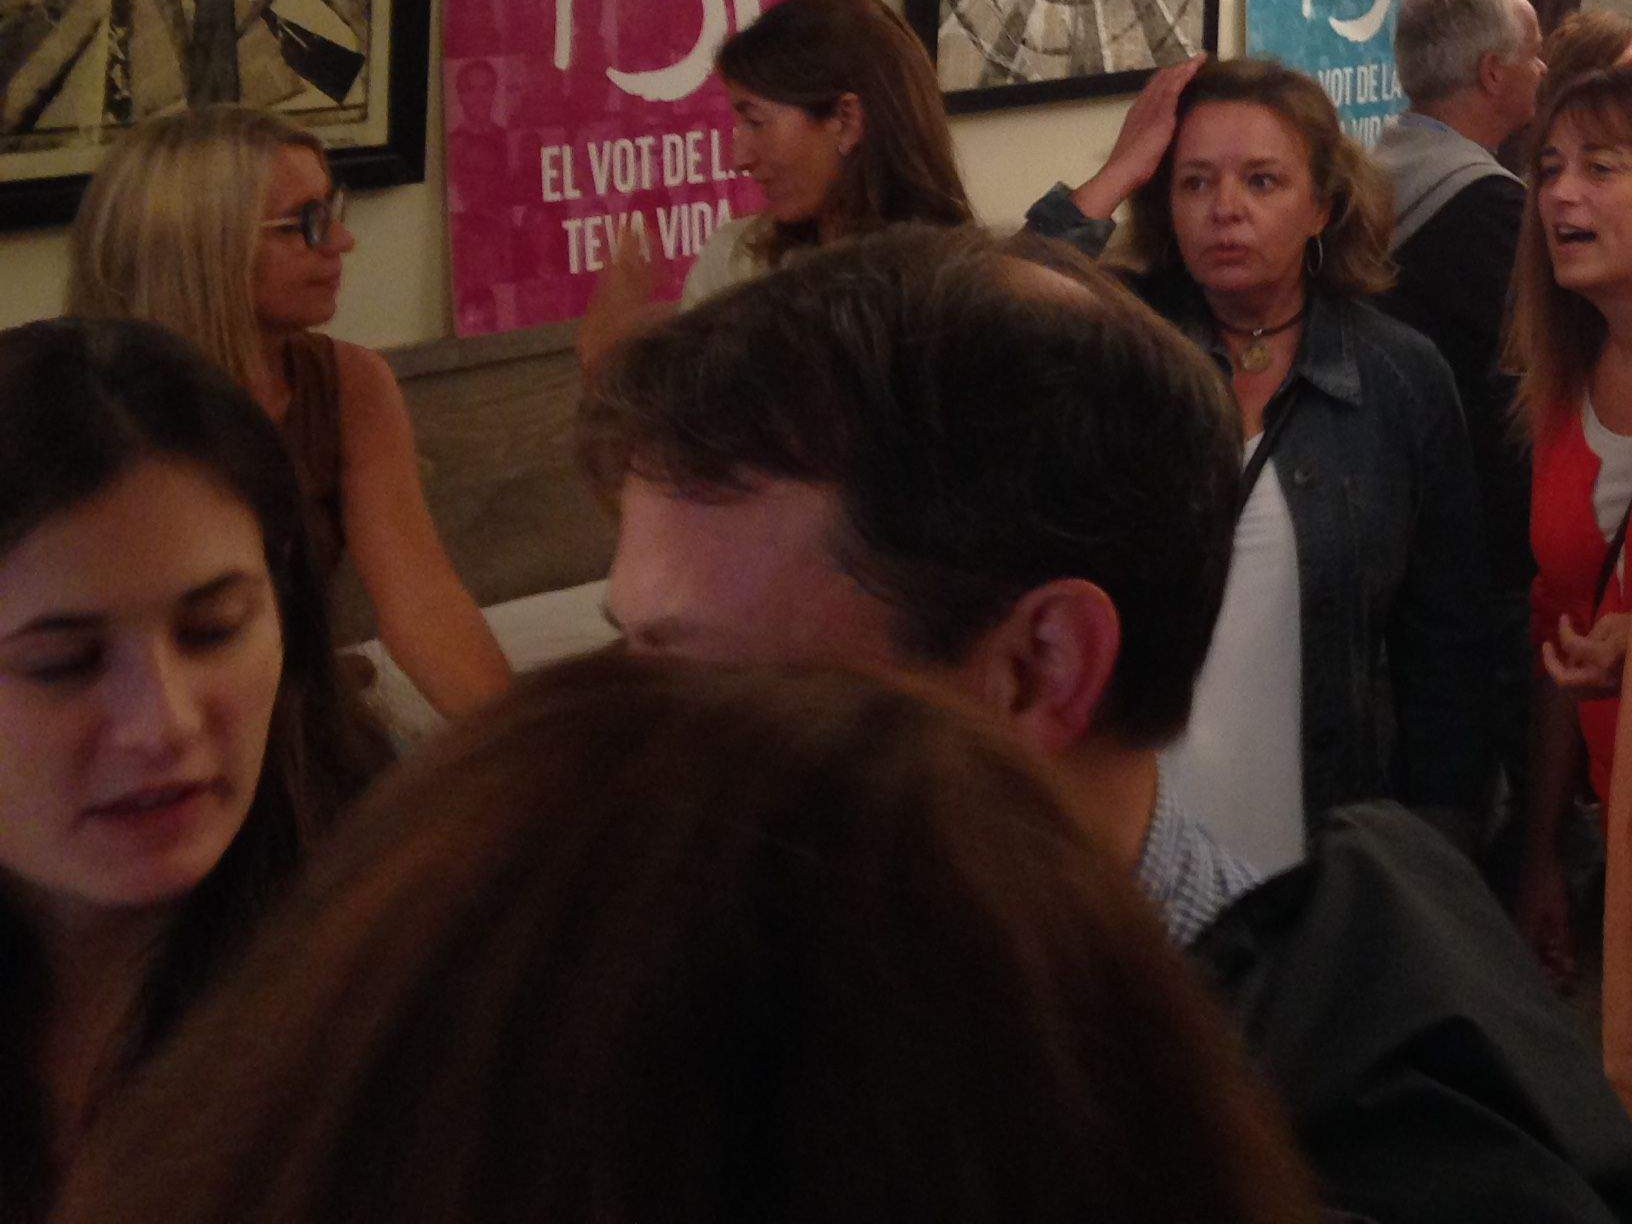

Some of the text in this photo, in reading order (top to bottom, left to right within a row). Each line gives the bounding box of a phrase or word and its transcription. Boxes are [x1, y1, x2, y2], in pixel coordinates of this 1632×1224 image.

[1357, 64, 1378, 104] DE
[541, 144, 581, 202] EL
[587, 136, 655, 195] VOT
[662, 130, 705, 188] DE
